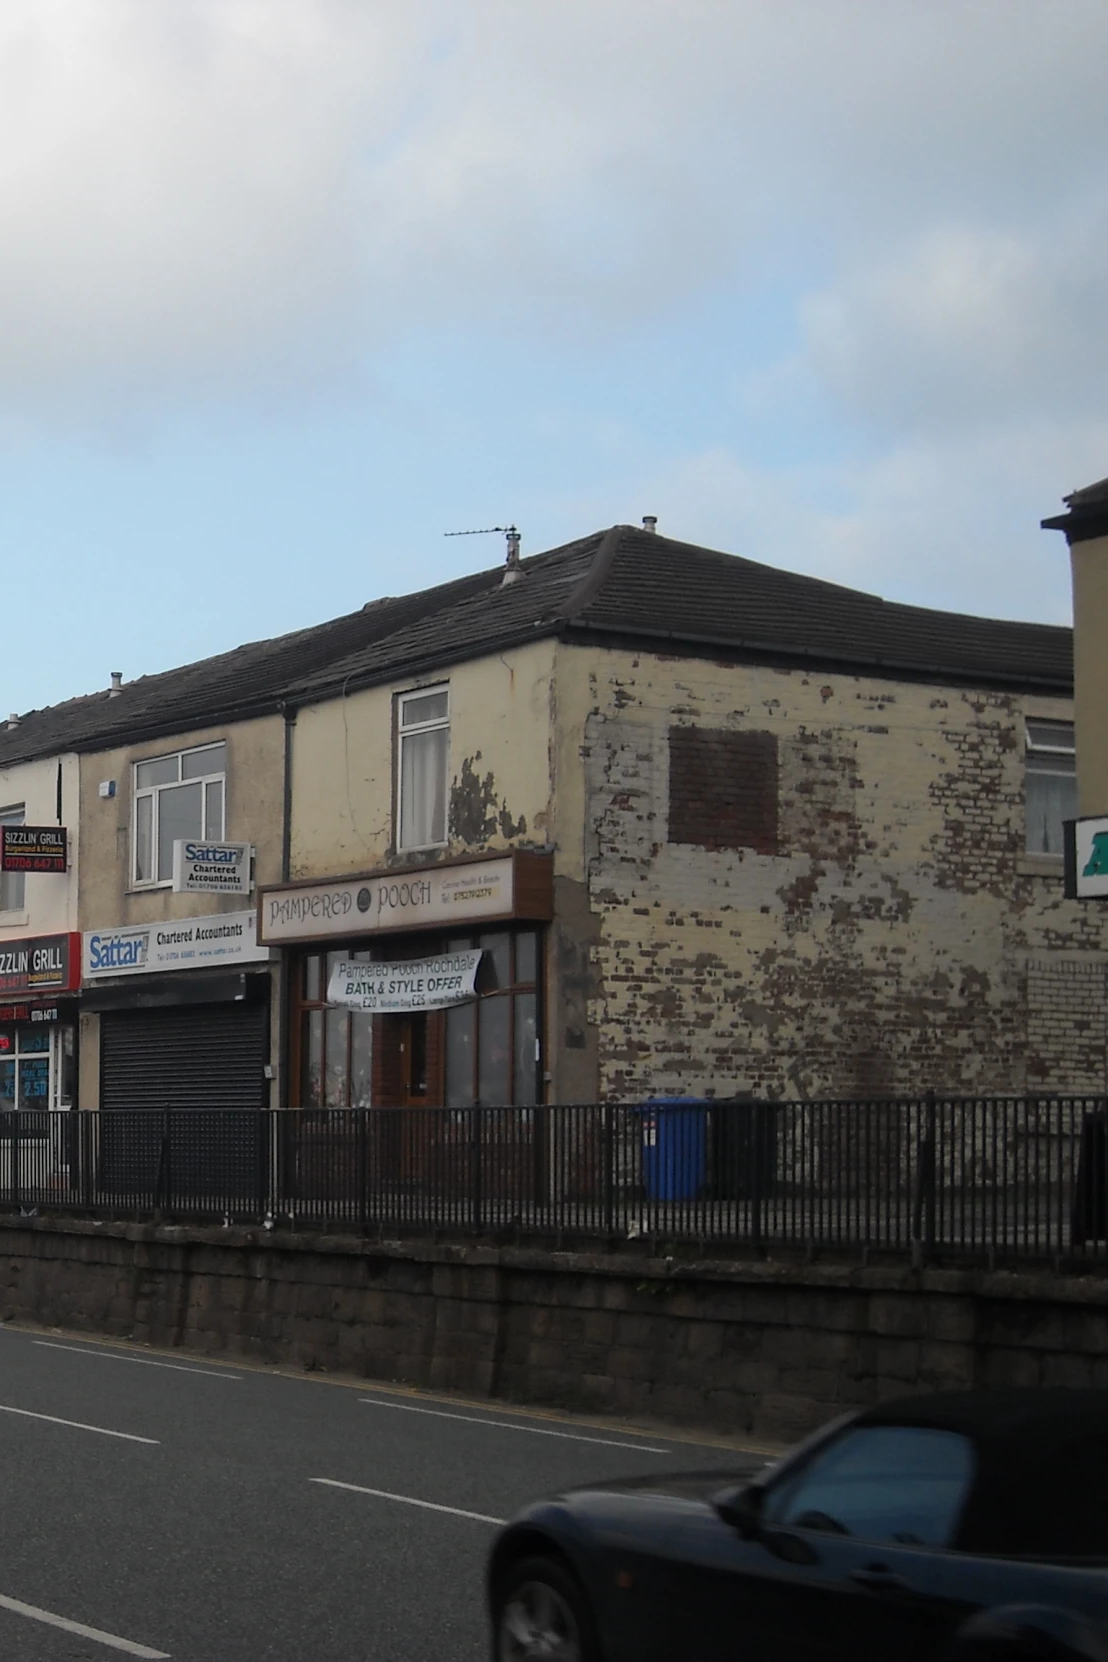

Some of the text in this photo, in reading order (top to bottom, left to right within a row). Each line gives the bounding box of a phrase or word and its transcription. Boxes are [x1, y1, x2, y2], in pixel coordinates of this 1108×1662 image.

[40, 833, 63, 845] GRILL
[185, 844, 237, 862] Sattar
[188, 873, 241, 883] Accountants
[193, 864, 236, 874] Chartered
[270, 880, 431, 926] PAMPERED POOCH
[157, 923, 243, 945] Chartered Accountants
[33, 947, 63, 971] GRILL
[90, 935, 142, 968] Sattar
[338, 962, 389, 978] Pampered
[426, 955, 476, 974] Rochdale
[345, 976, 463, 995] BATH & STYLE OFFER
[362, 997, 377, 1007] £20
[412, 994, 426, 1005] £25
